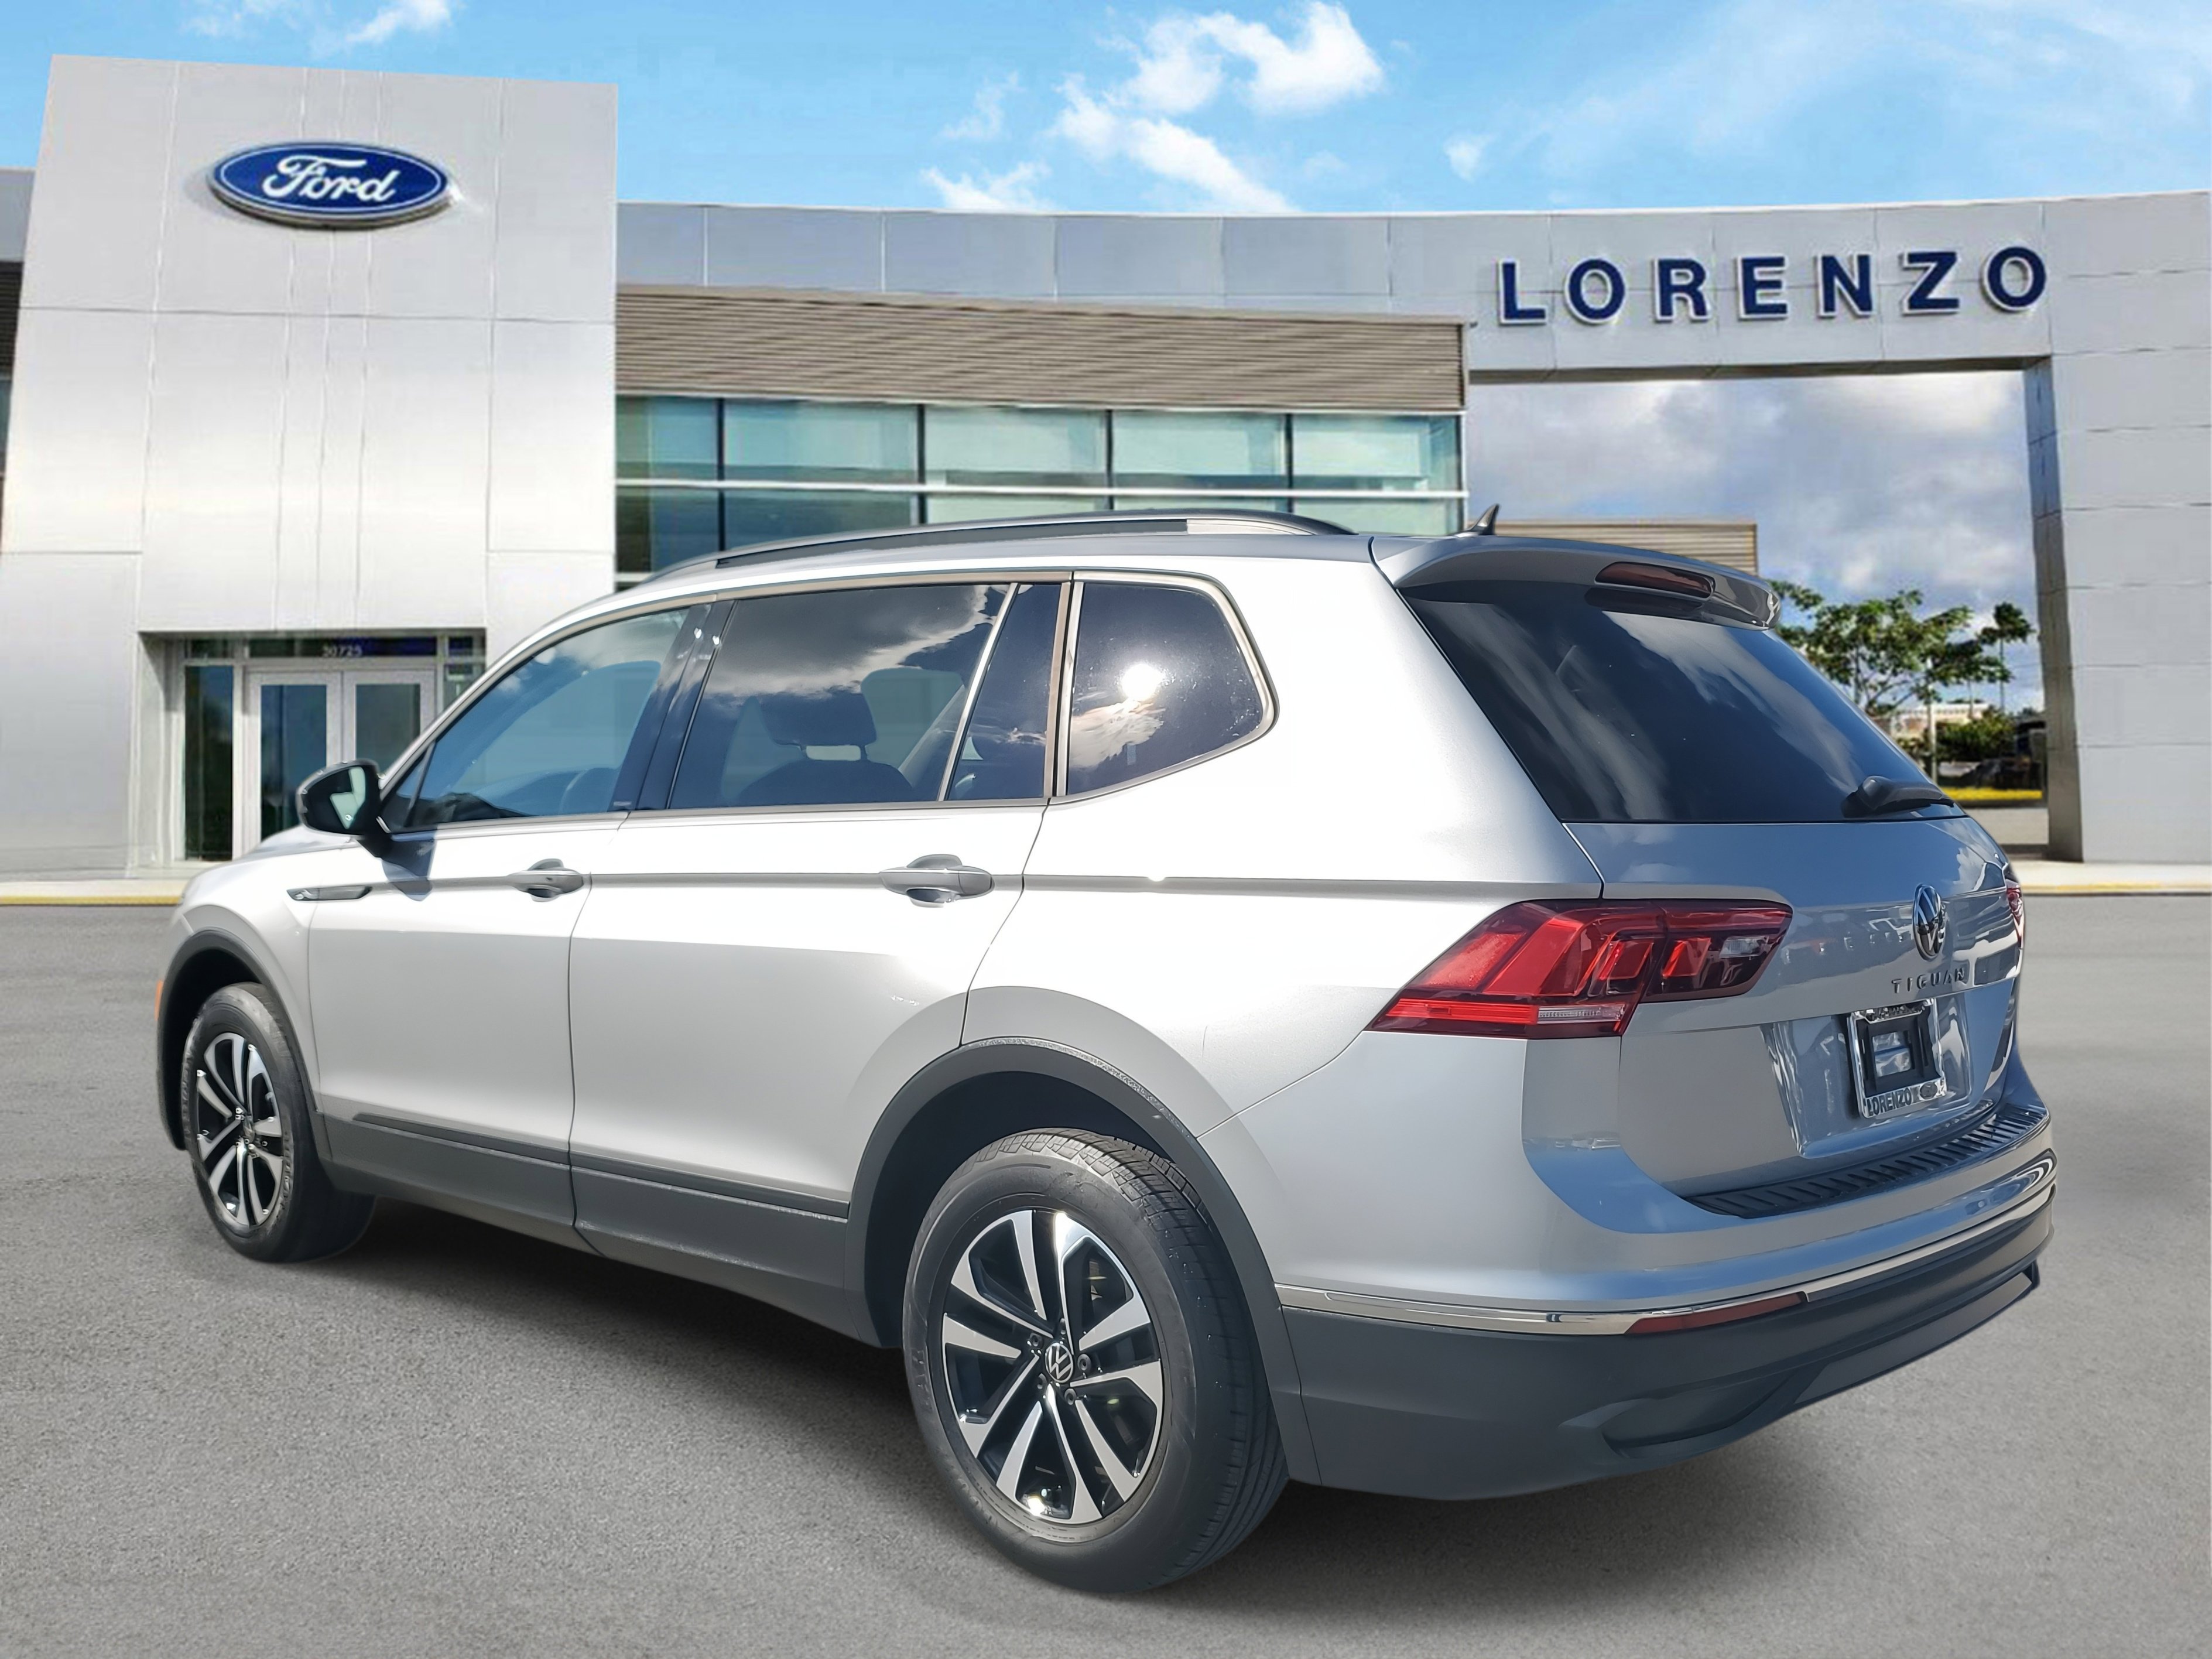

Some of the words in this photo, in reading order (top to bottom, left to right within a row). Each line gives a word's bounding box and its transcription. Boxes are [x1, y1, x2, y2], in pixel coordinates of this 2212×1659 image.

[261, 154, 400, 202] Ford
[1498, 247, 2047, 324] LORENZO
[1891, 967, 1965, 994] TIGUAN
[1867, 1087, 1912, 1117] LORENZO
